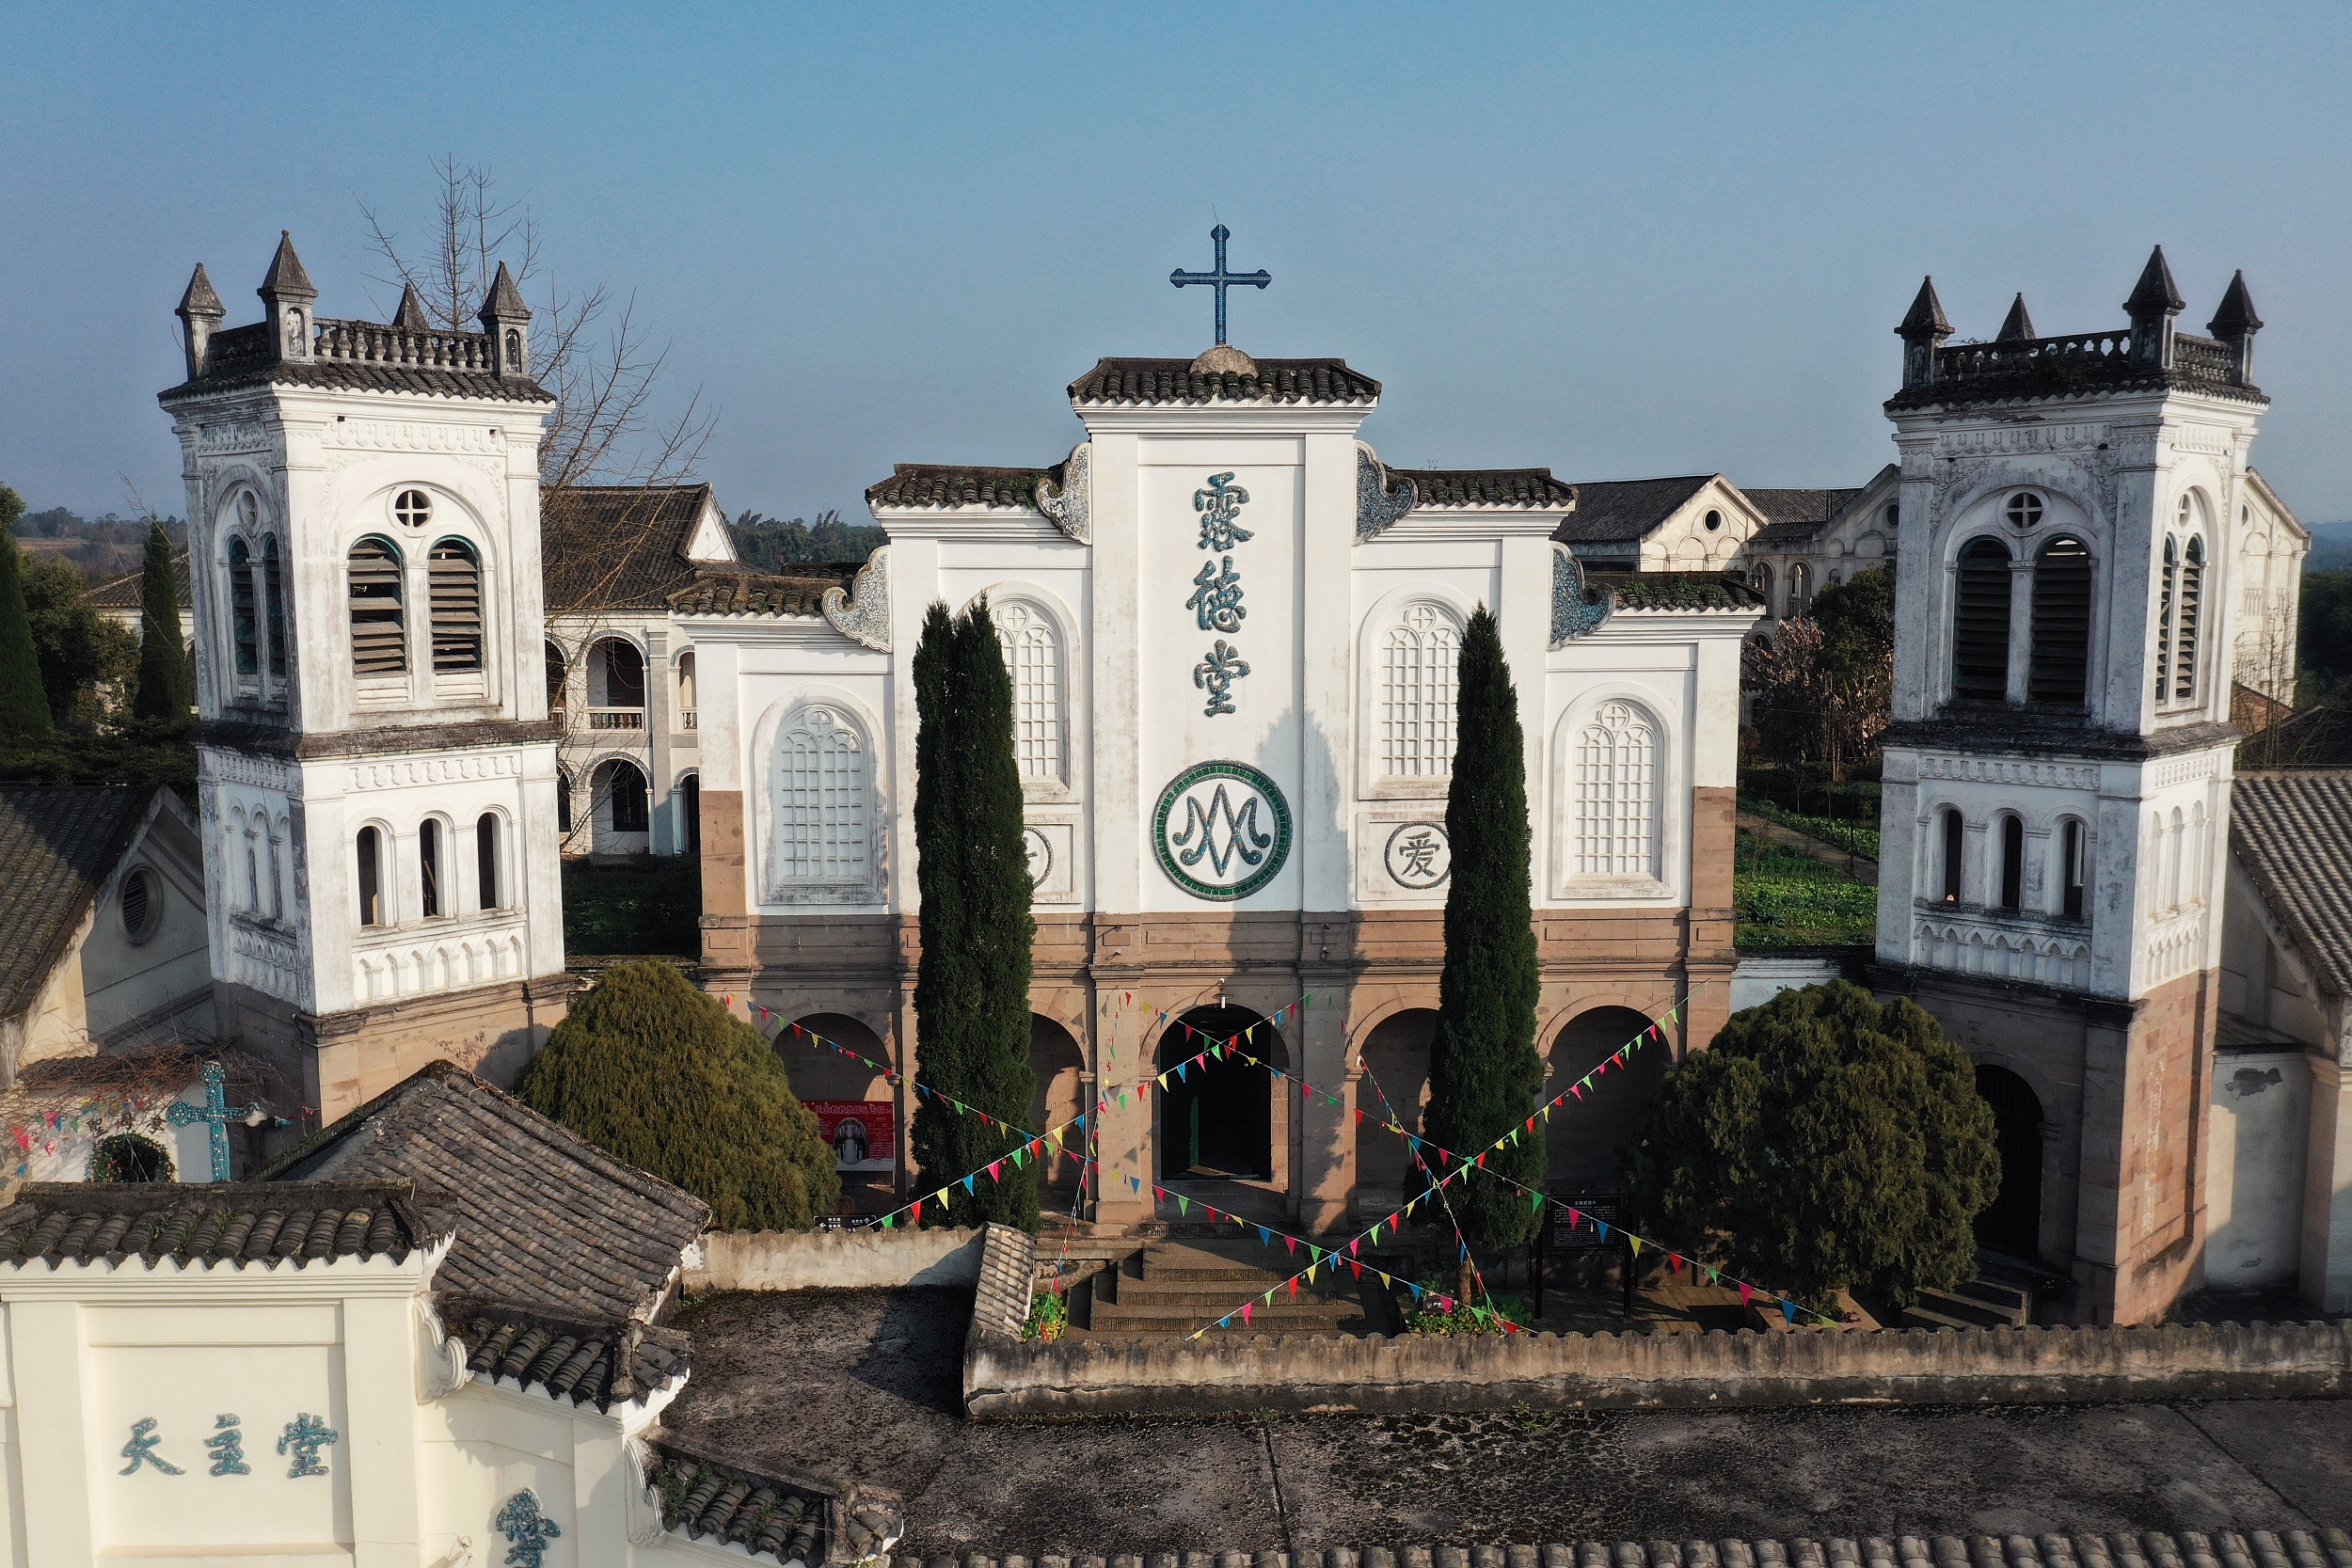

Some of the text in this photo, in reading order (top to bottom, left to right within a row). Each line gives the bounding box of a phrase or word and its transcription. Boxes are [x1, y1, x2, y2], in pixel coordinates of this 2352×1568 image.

[1399, 831, 1440, 877] 爱
[118, 1412, 338, 1478] 天主堂
